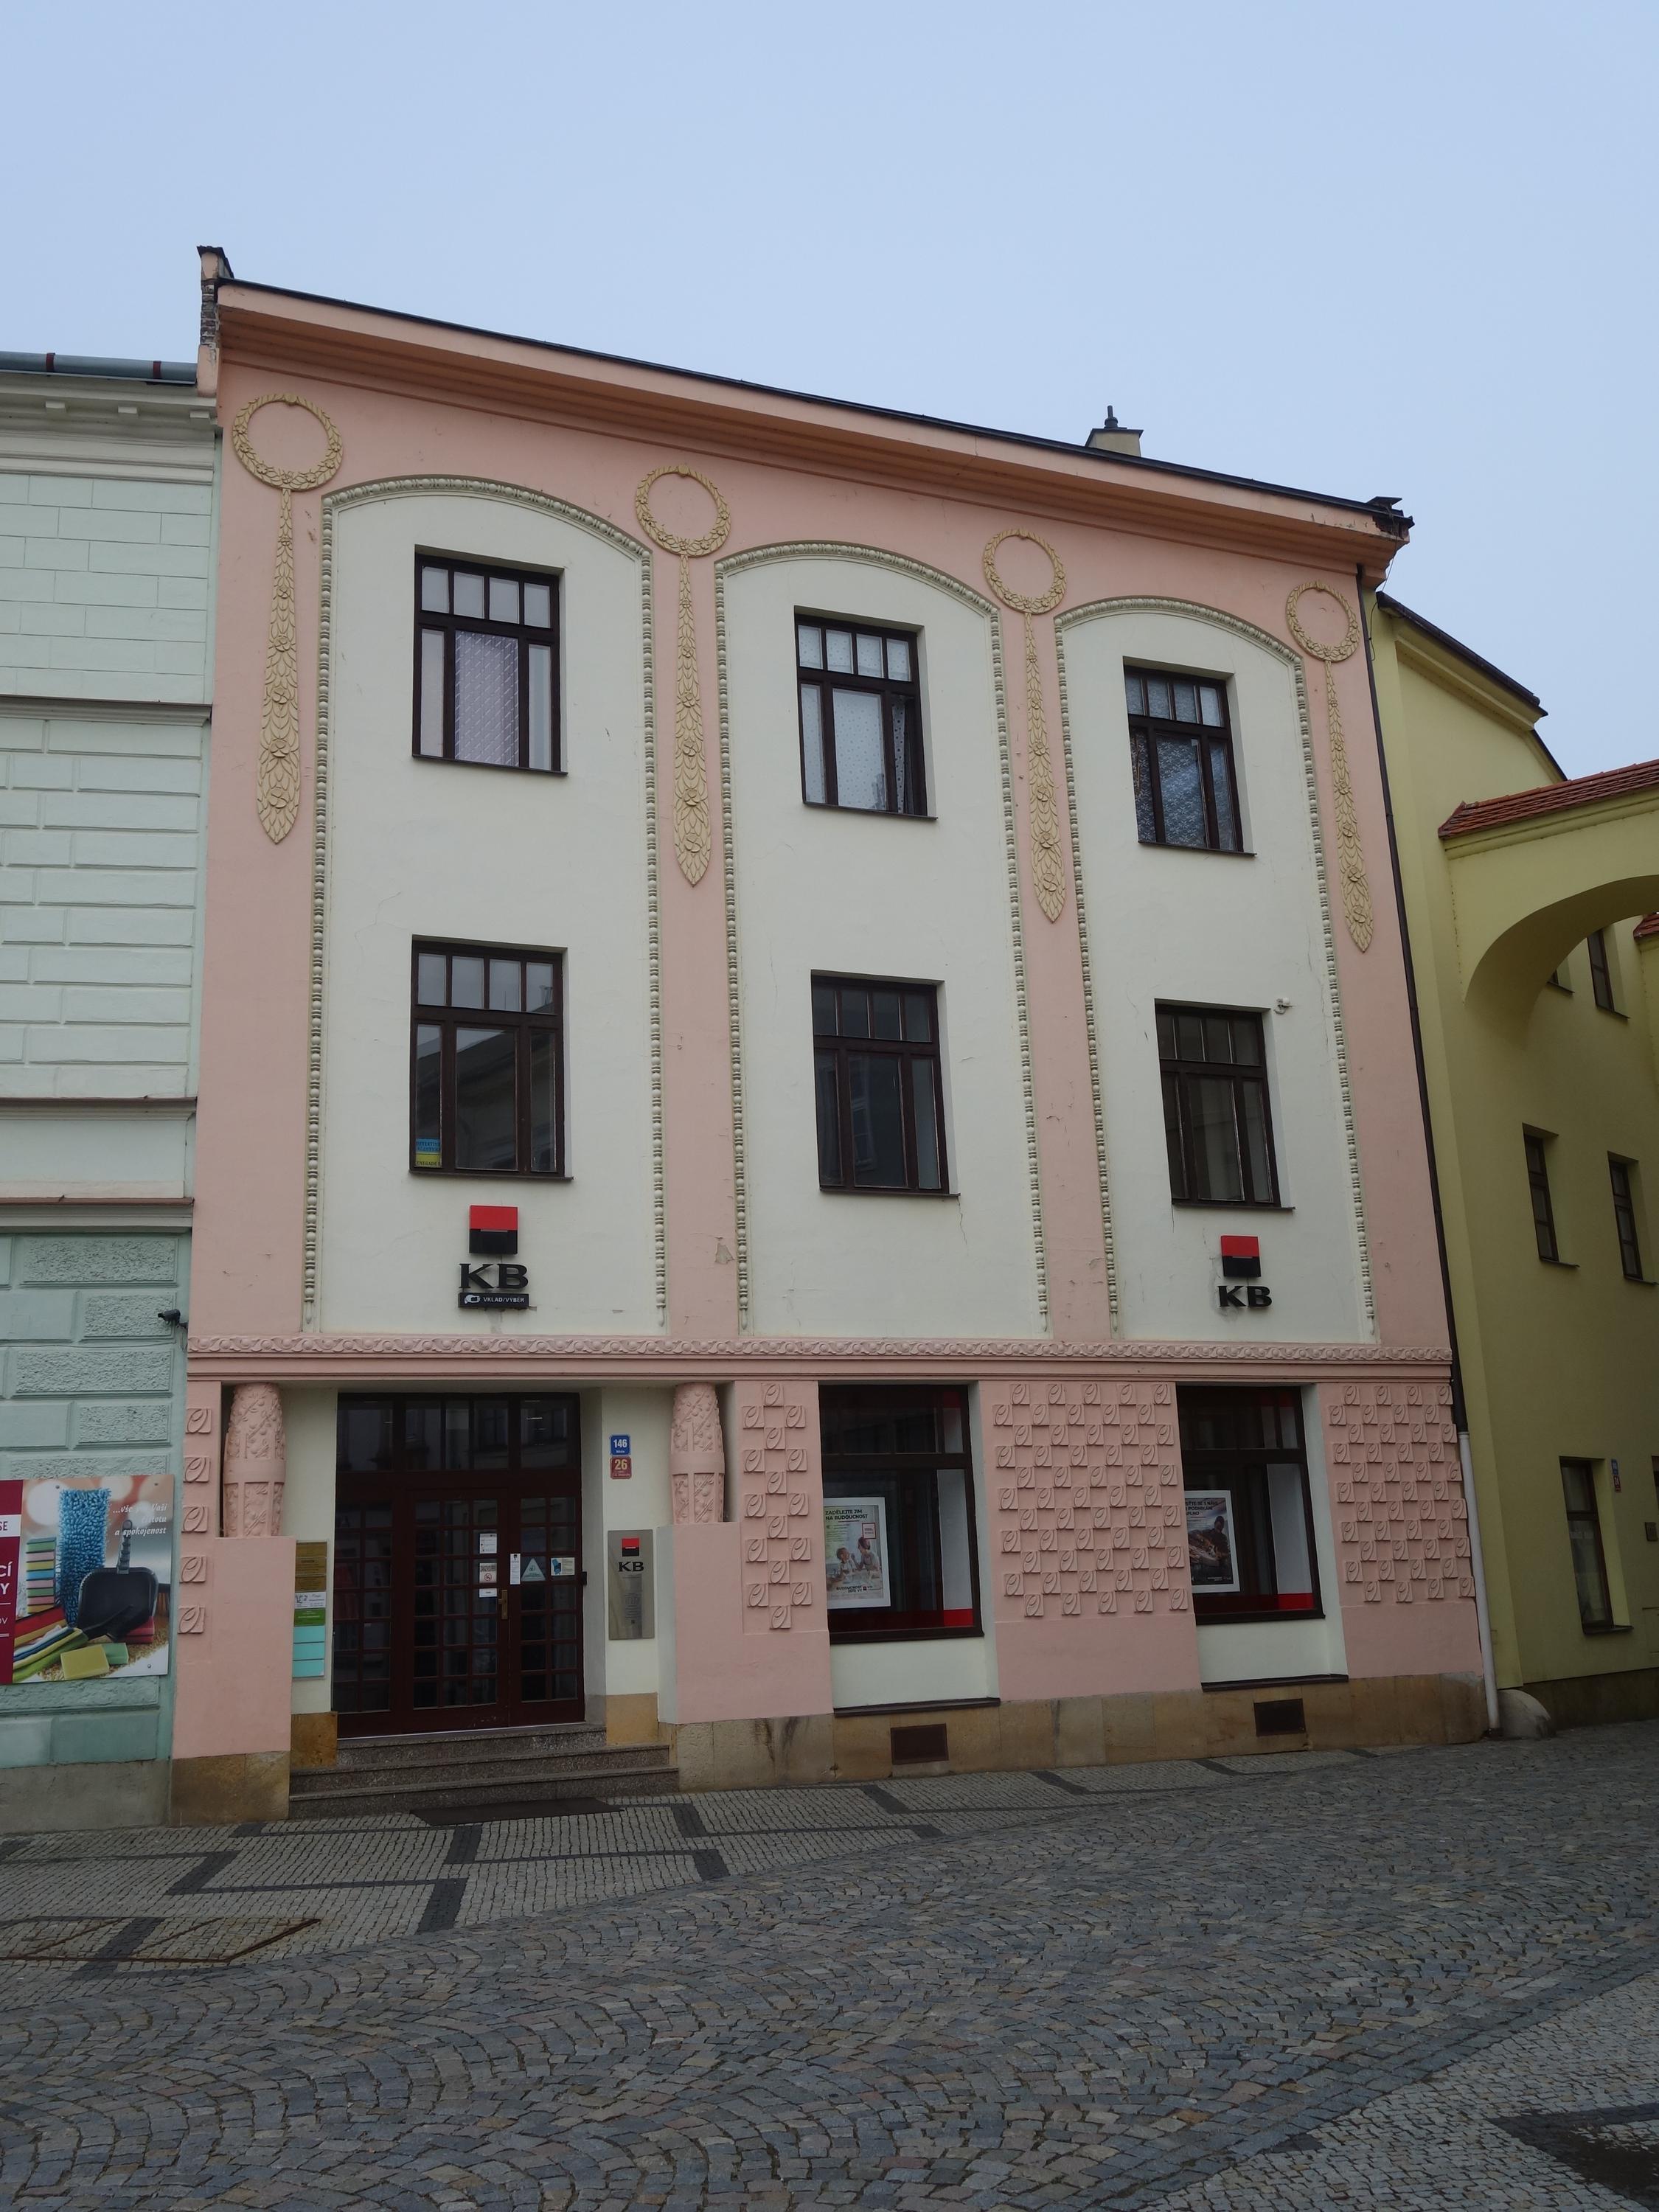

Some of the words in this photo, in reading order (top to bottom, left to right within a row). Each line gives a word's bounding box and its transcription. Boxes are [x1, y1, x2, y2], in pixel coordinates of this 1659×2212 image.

[459, 1263, 529, 1289] KB
[1217, 1285, 1273, 1307] KB
[613, 1439, 627, 1448] 146
[614, 1458, 627, 1470] 26
[122, 1527, 167, 1537] spokojenost
[618, 1561, 644, 1572] KB
